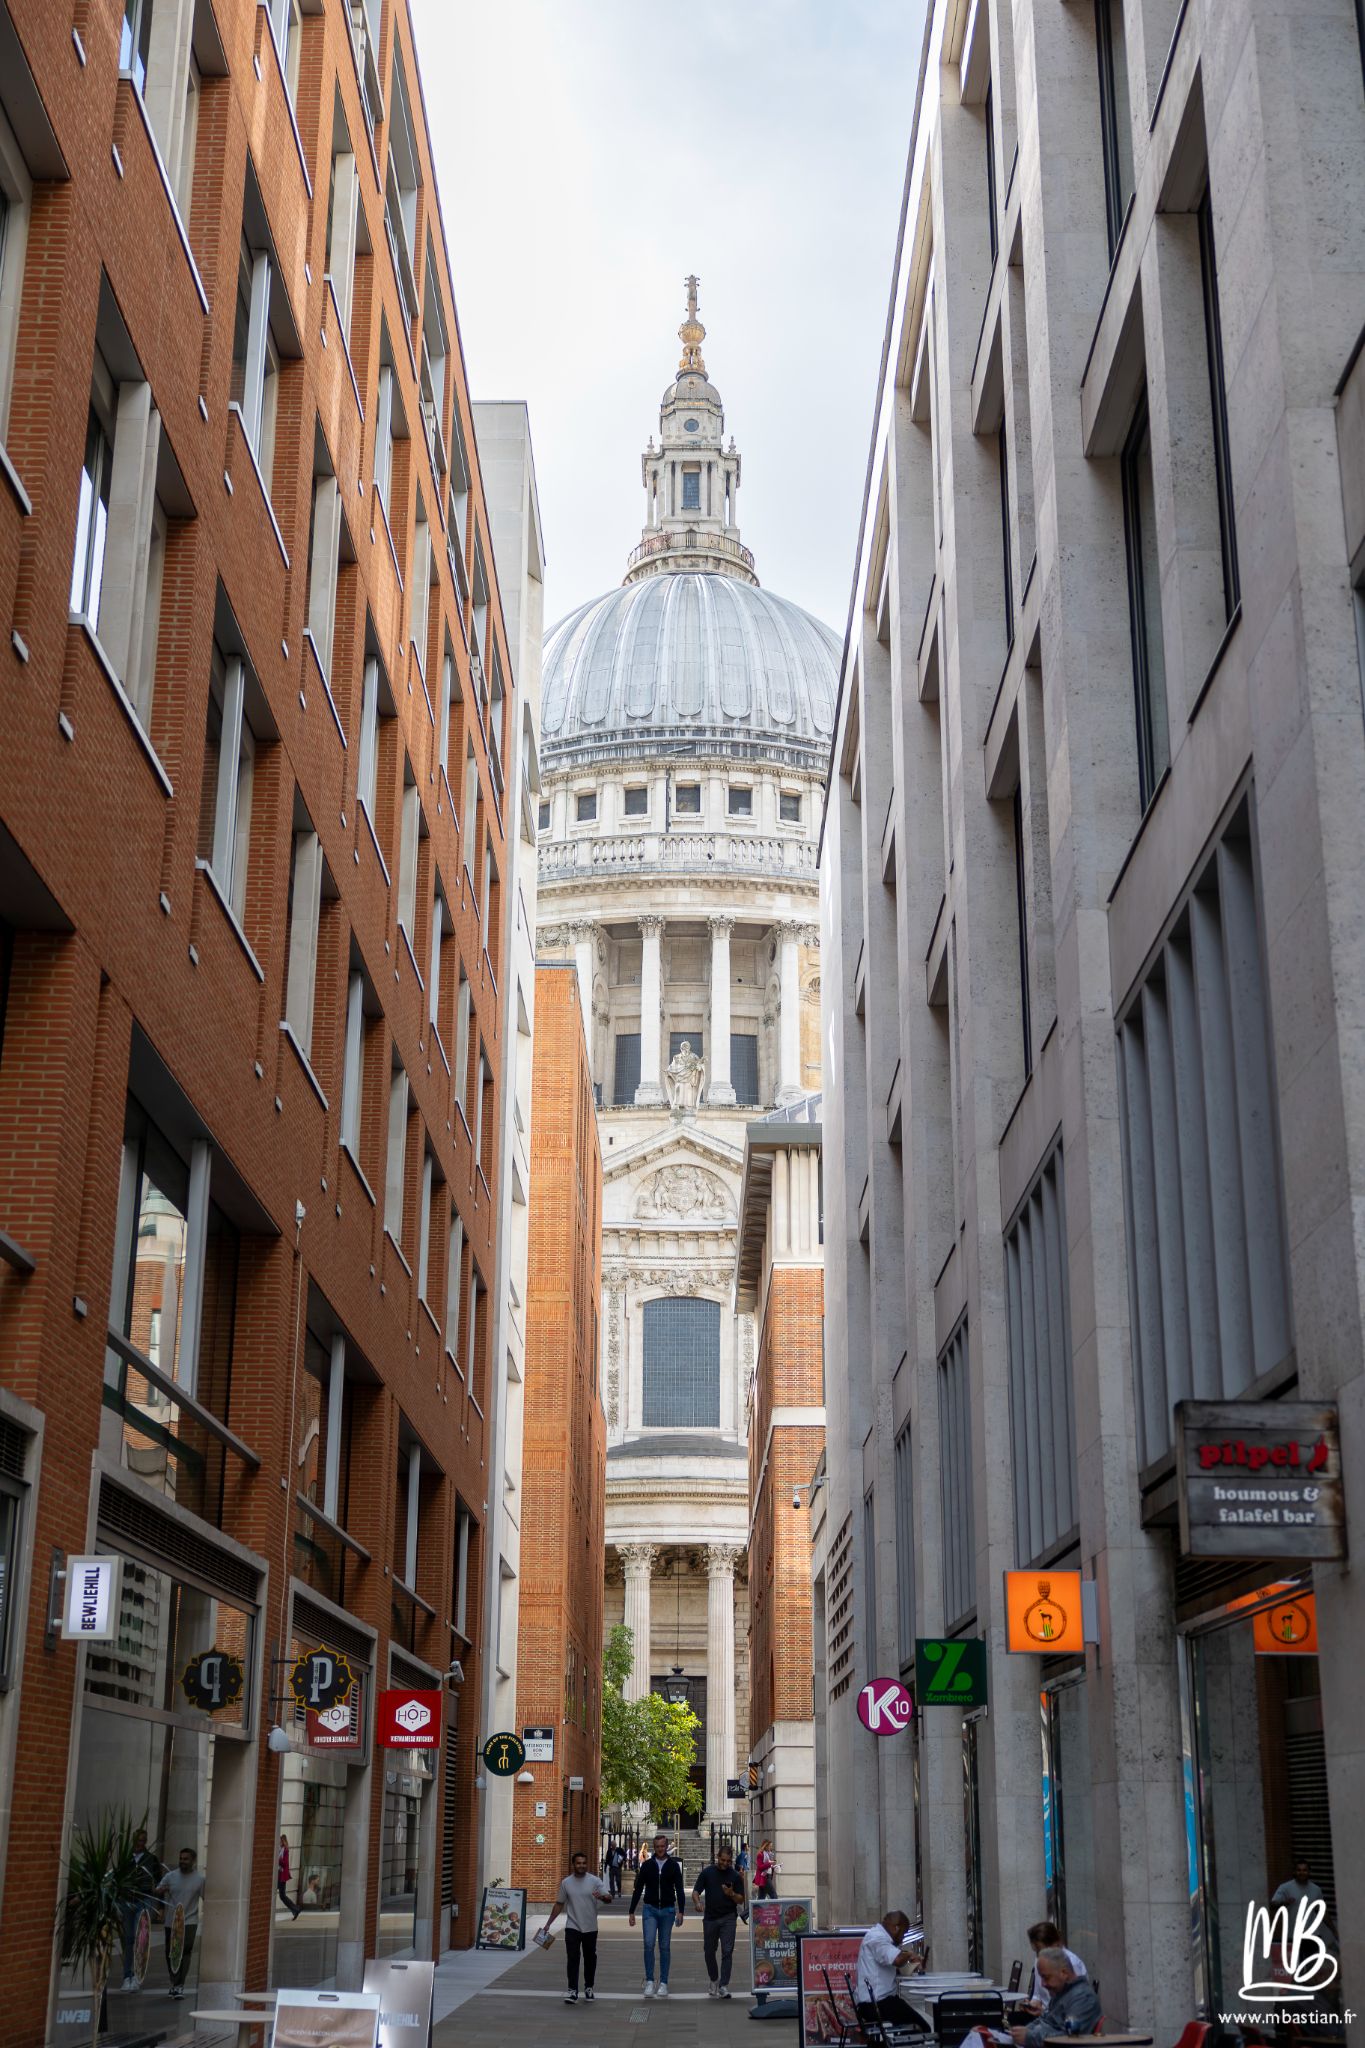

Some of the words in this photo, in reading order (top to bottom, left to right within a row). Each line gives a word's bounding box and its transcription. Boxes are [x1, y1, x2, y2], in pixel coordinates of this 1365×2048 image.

[1199, 1439, 1300, 1470] pilpel
[1214, 1486, 1299, 1501] houmous
[1303, 1487, 1319, 1501] &
[1219, 1508, 1279, 1523] falafel
[1282, 1509, 1315, 1523] bar
[81, 1567, 100, 1630] BEWLIEHILL
[926, 1693, 973, 1702] Zambrero
[769, 1949, 796, 1958] Bowls
[828, 1963, 856, 1971] PROTEI
